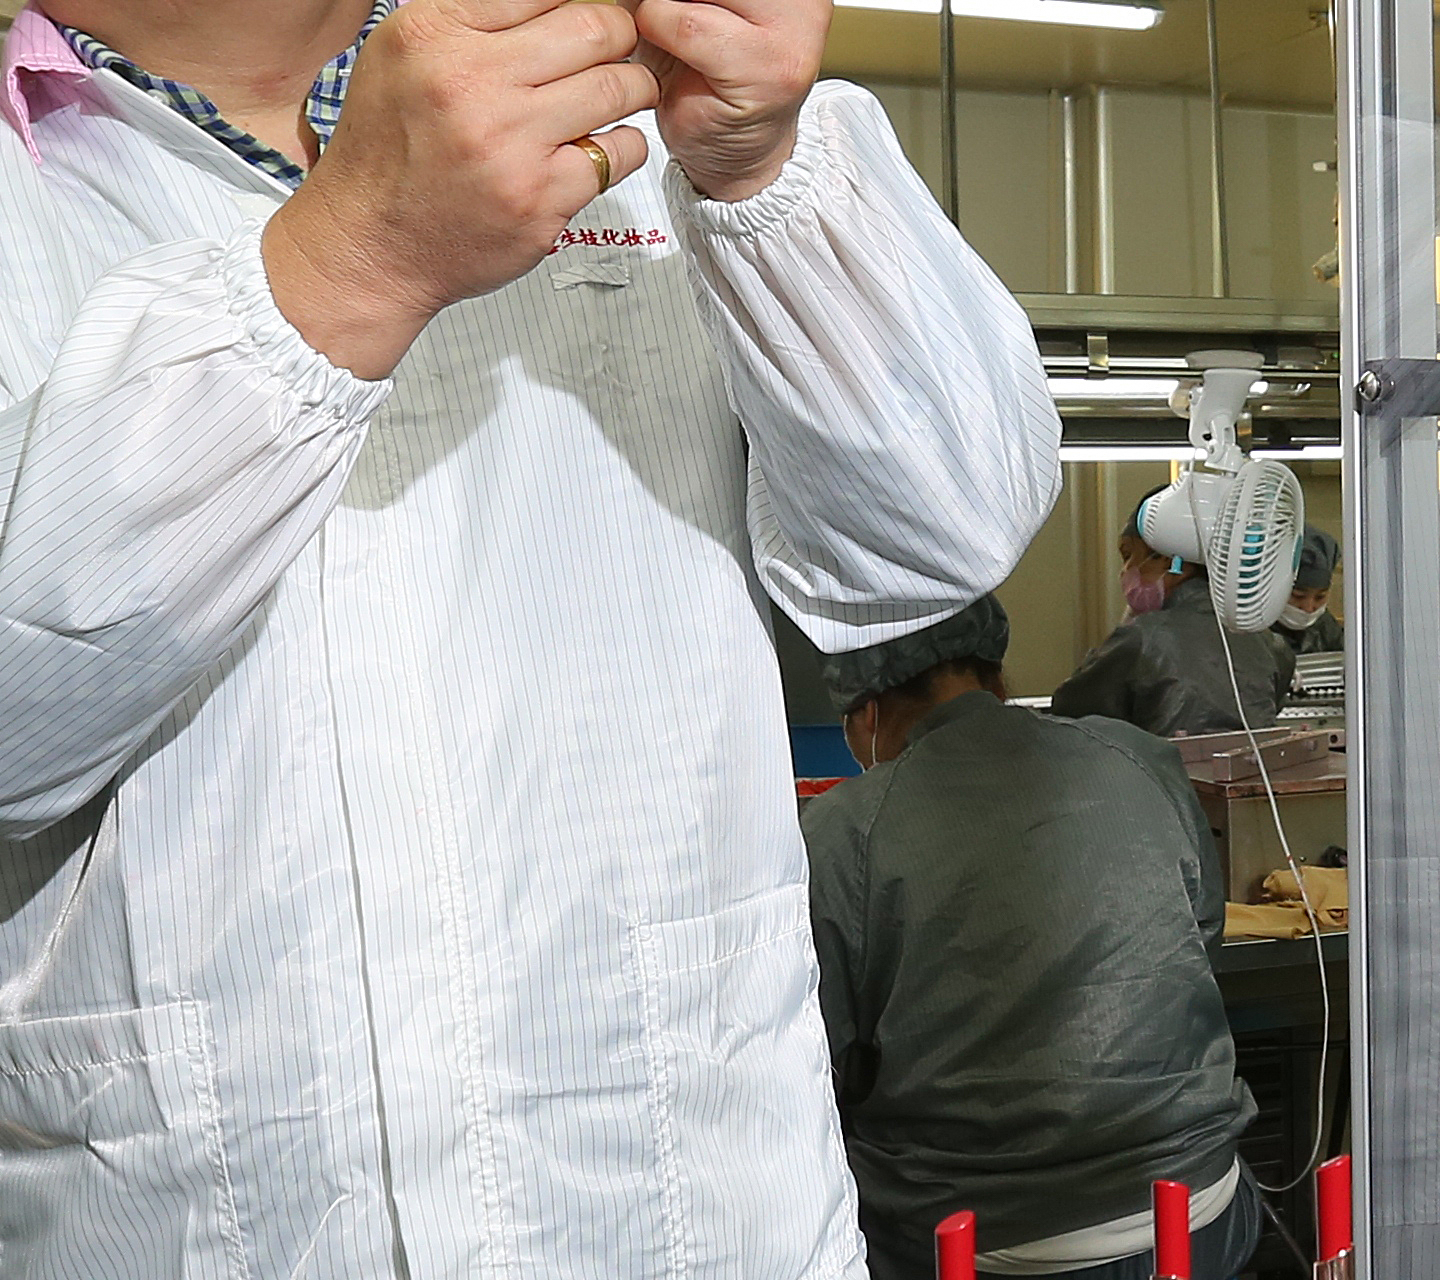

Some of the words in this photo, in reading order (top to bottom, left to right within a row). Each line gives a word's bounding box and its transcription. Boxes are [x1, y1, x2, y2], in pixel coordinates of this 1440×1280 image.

[546, 227, 668, 255] 生技化妆品
